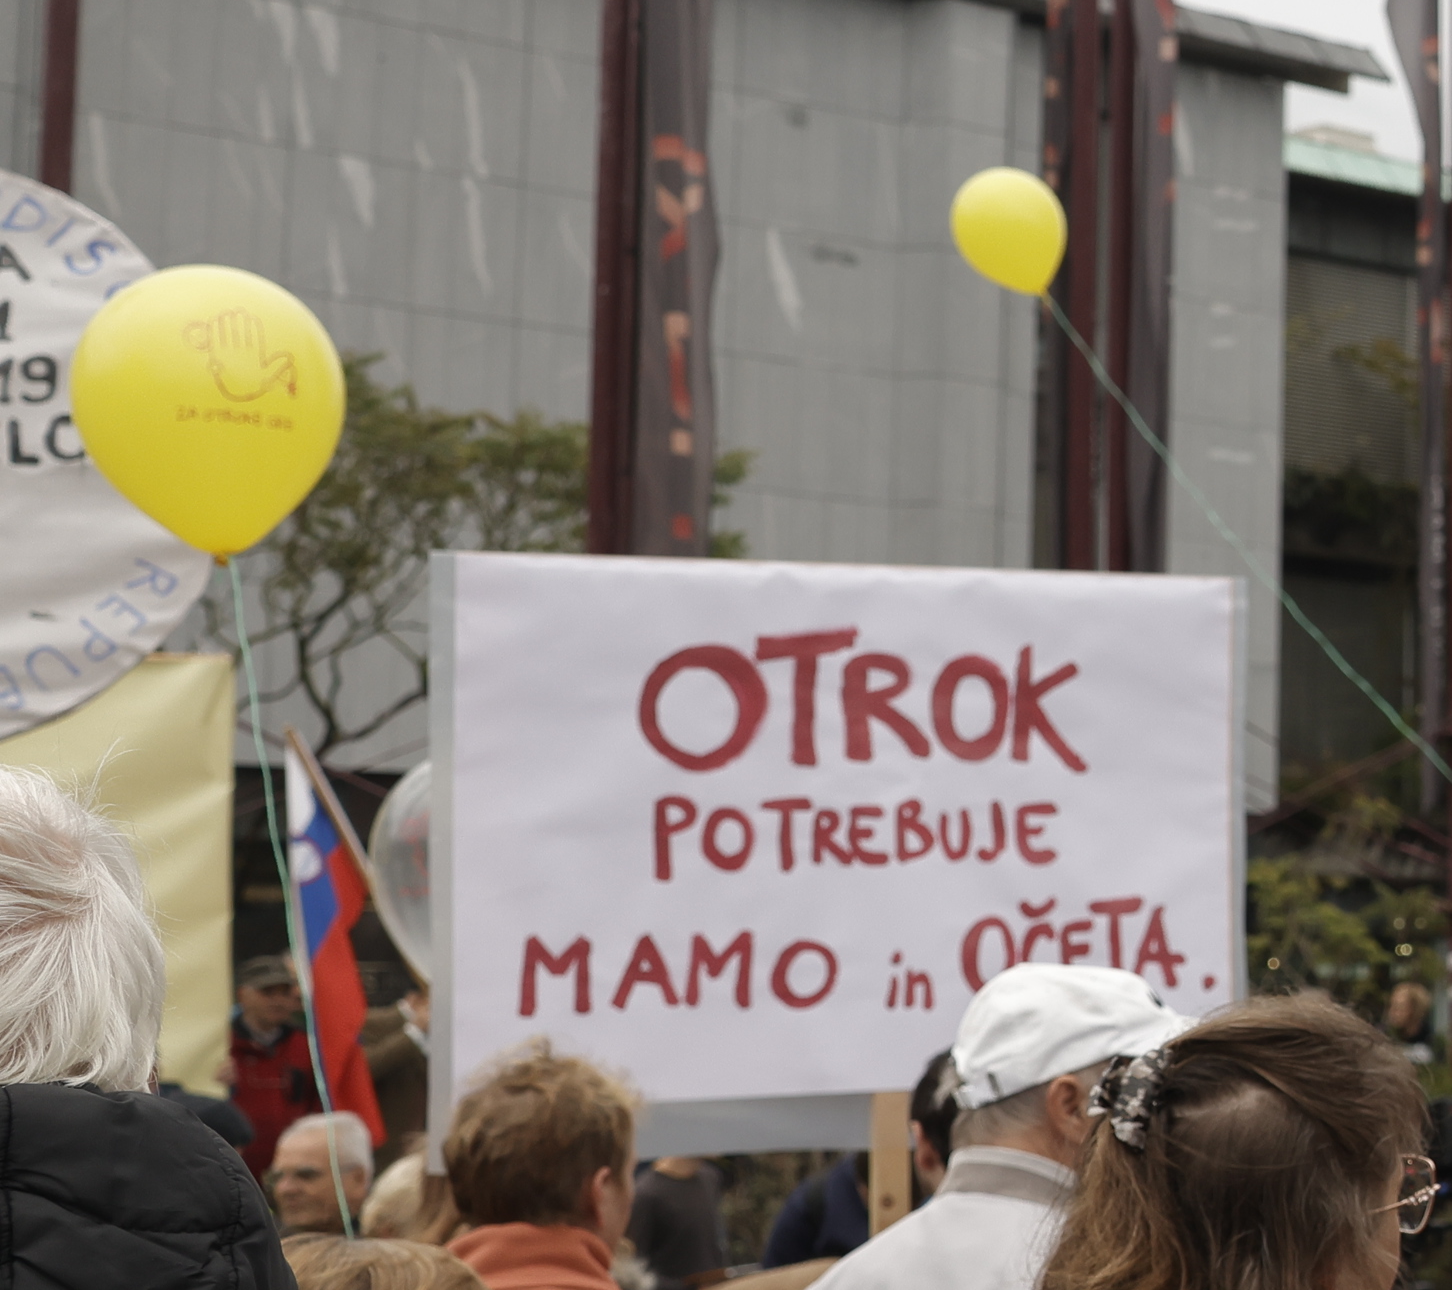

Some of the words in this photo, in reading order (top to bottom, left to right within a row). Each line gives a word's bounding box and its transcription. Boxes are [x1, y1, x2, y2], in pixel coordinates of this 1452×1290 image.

[636, 627, 1089, 773] OTROK
[653, 794, 1060, 881] POTREBUJE
[517, 929, 840, 1017] MAMO
[887, 951, 935, 1011] in
